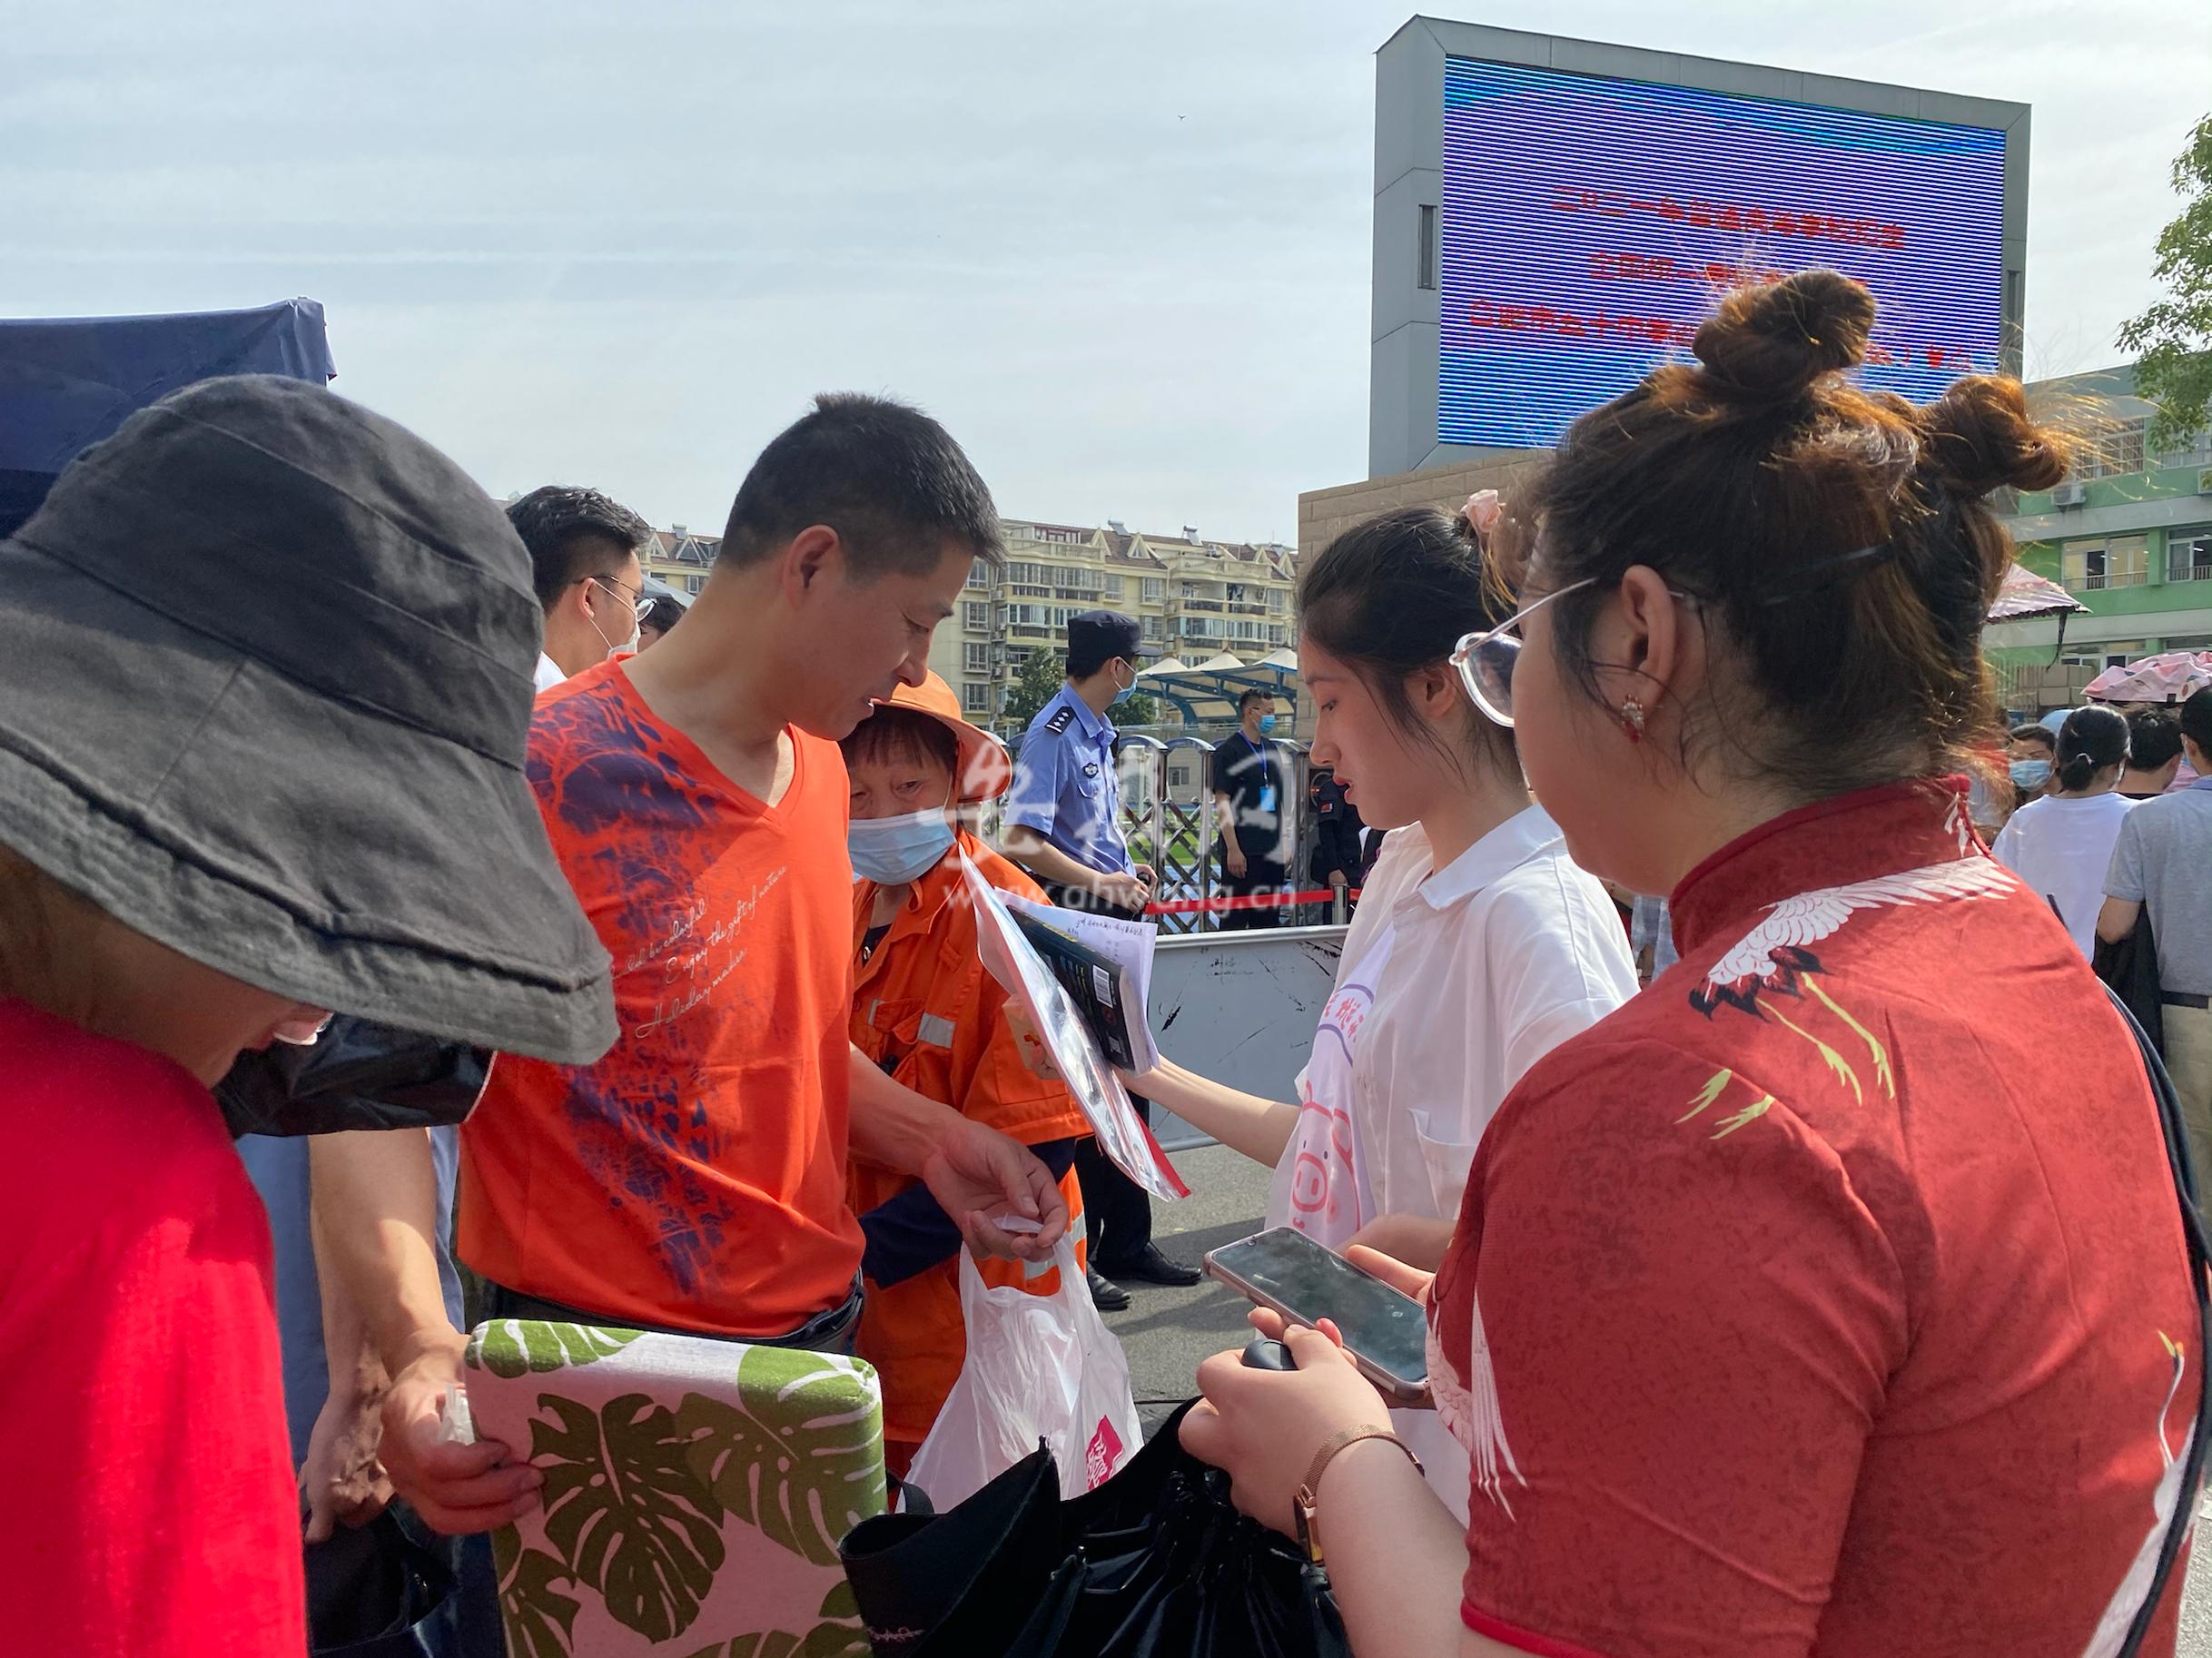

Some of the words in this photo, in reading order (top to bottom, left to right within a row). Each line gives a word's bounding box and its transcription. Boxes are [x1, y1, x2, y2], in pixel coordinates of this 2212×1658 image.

[665, 947, 708, 984] Enjoy
[706, 920, 726, 946] the
[726, 899, 747, 942] gift
[759, 865, 786, 898] nature
